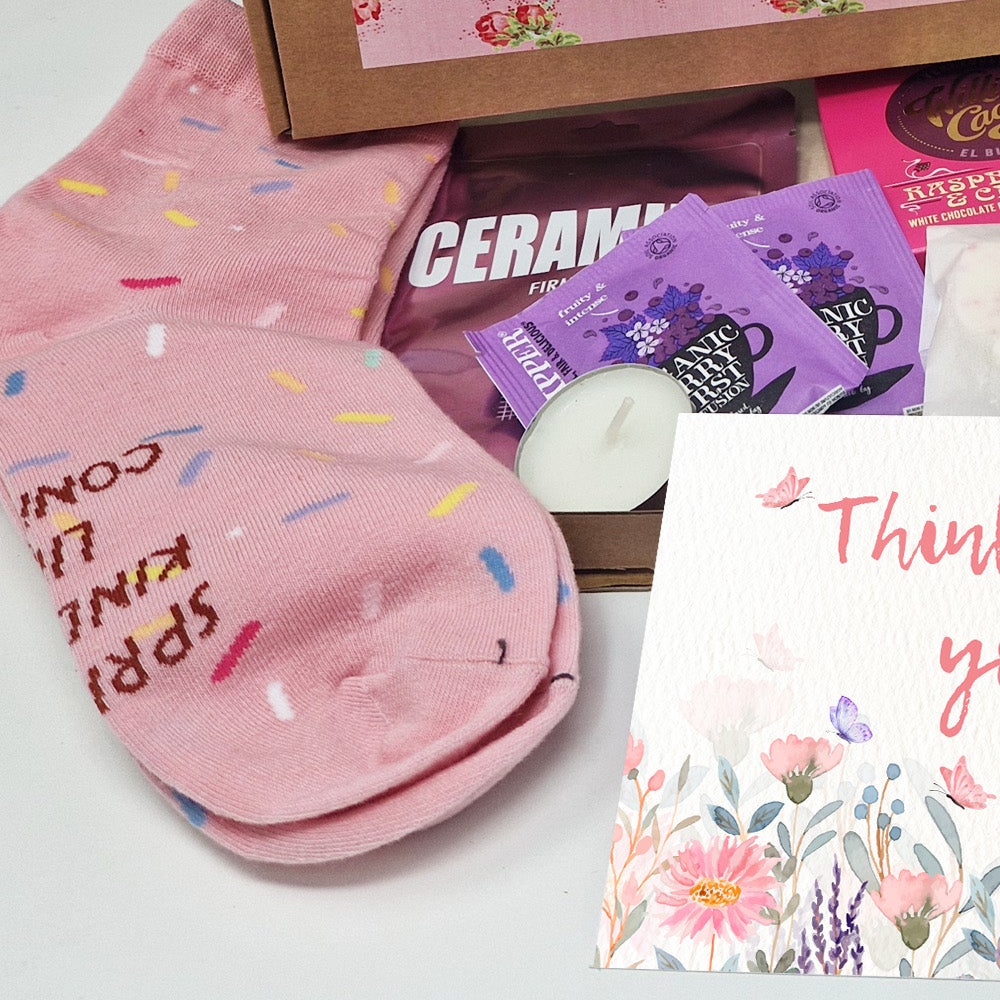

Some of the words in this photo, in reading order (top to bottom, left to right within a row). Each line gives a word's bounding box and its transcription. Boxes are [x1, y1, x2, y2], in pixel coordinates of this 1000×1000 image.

[959, 148, 979, 159] EL
[947, 192, 968, 207] &
[726, 219, 749, 229] uity
[754, 213, 766, 222] &
[908, 213, 940, 229] WHITE
[941, 203, 997, 222] CHOCOLATE
[408, 203, 678, 288] CERAM
[558, 292, 591, 318] fruity
[565, 294, 609, 326] intense
[523, 321, 556, 357] DELICIOUS
[664, 325, 740, 379] ANIC
[551, 351, 560, 362] &
[555, 358, 573, 377] FAIR
[20, 442, 163, 520] CON
